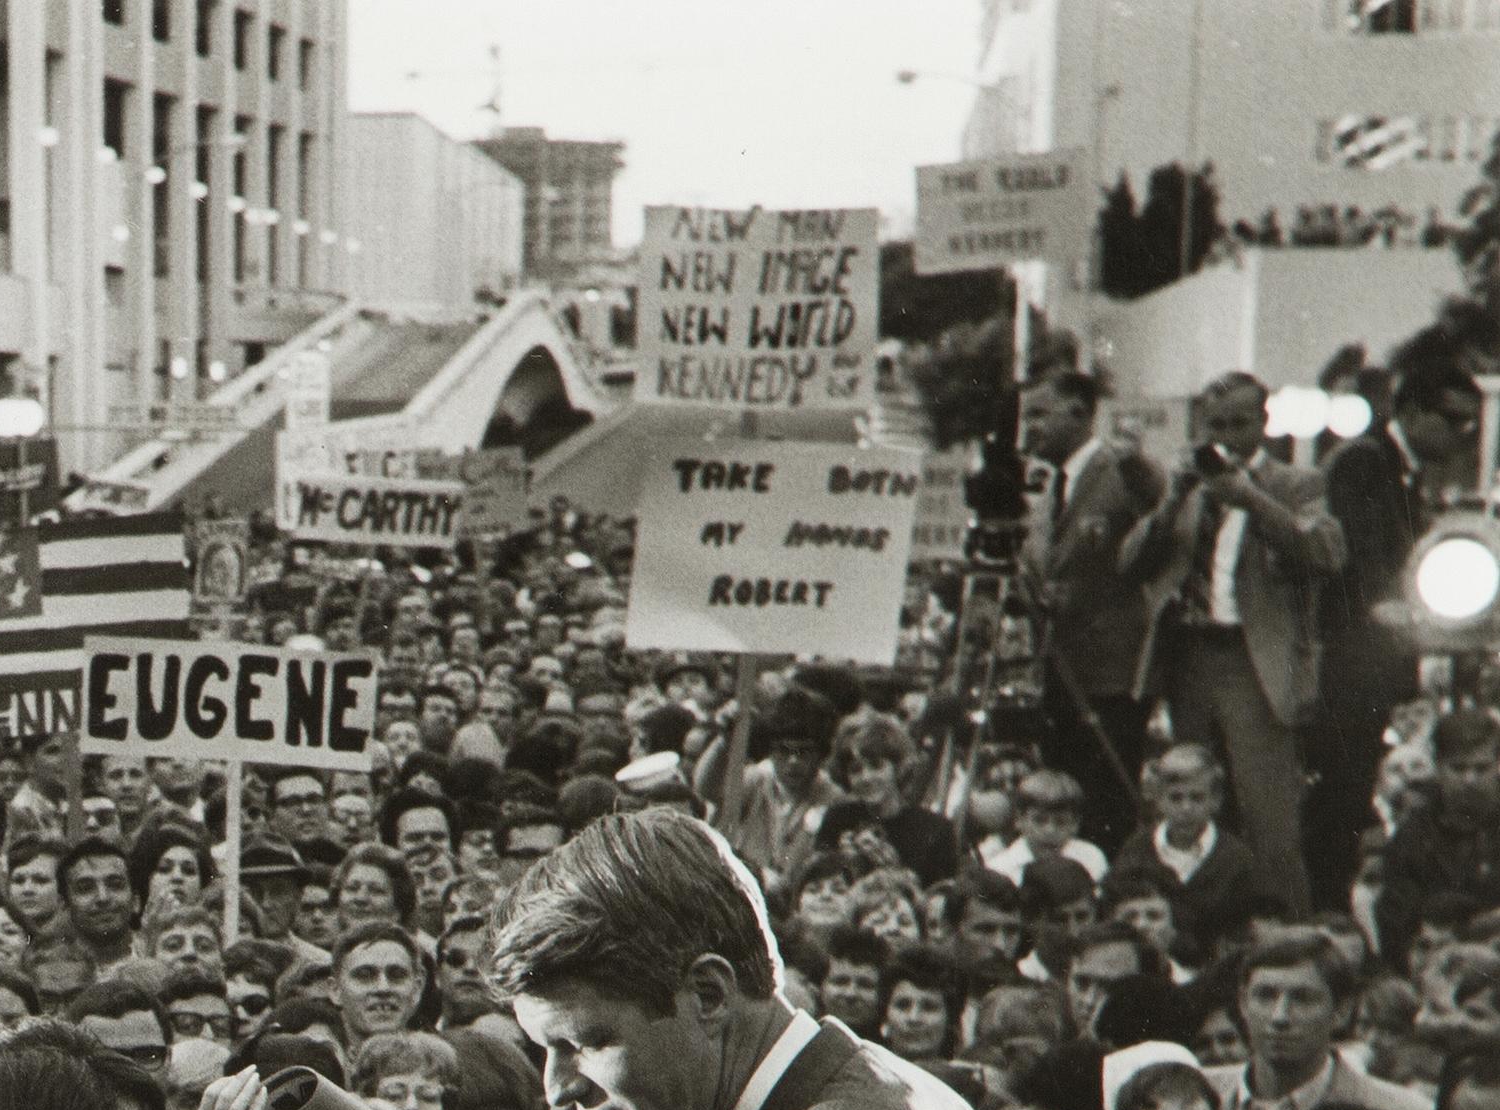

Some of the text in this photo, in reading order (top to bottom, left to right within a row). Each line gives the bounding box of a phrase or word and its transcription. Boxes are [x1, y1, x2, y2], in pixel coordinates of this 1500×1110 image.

[671, 205, 763, 243] NEW
[659, 250, 736, 294] NEW
[660, 303, 730, 346] NEW
[656, 354, 819, 406] KENNEDY
[672, 458, 775, 493] TAKE
[297, 480, 462, 537] McCARTHY
[700, 521, 745, 547] MY
[708, 574, 835, 609] ROBERT
[87, 652, 374, 752] EUGENE
